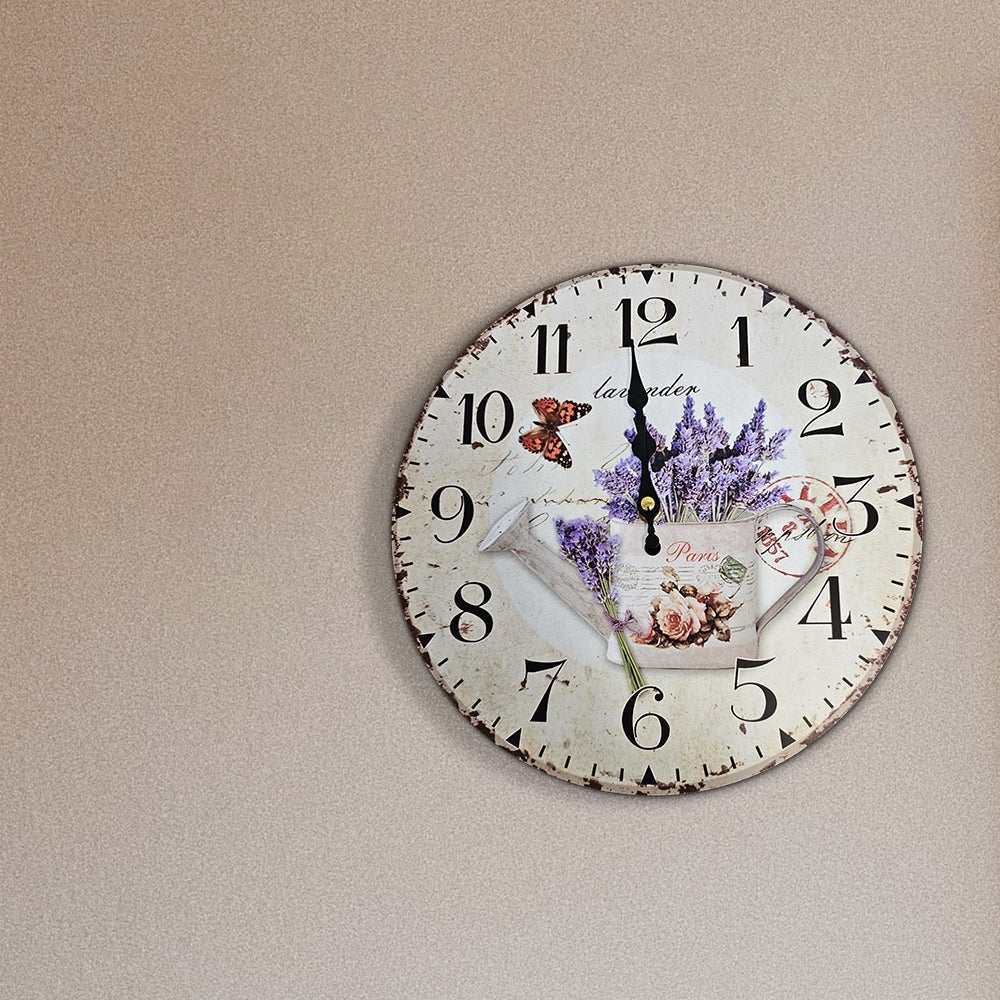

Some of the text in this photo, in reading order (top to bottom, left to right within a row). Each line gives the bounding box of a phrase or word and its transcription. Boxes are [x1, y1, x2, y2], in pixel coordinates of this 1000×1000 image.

[531, 324, 570, 375] 11
[615, 297, 679, 347] 12
[731, 316, 753, 368] 1
[593, 373, 700, 399] lavnder
[797, 378, 844, 437] 2
[457, 390, 515, 445] 10
[430, 485, 475, 544] 9
[832, 474, 879, 536] 3
[665, 540, 721, 563] Paris
[449, 581, 495, 643] 8
[797, 575, 853, 641] 4
[524, 658, 568, 722] 7
[621, 685, 672, 751] 6
[730, 657, 779, 722] 5
